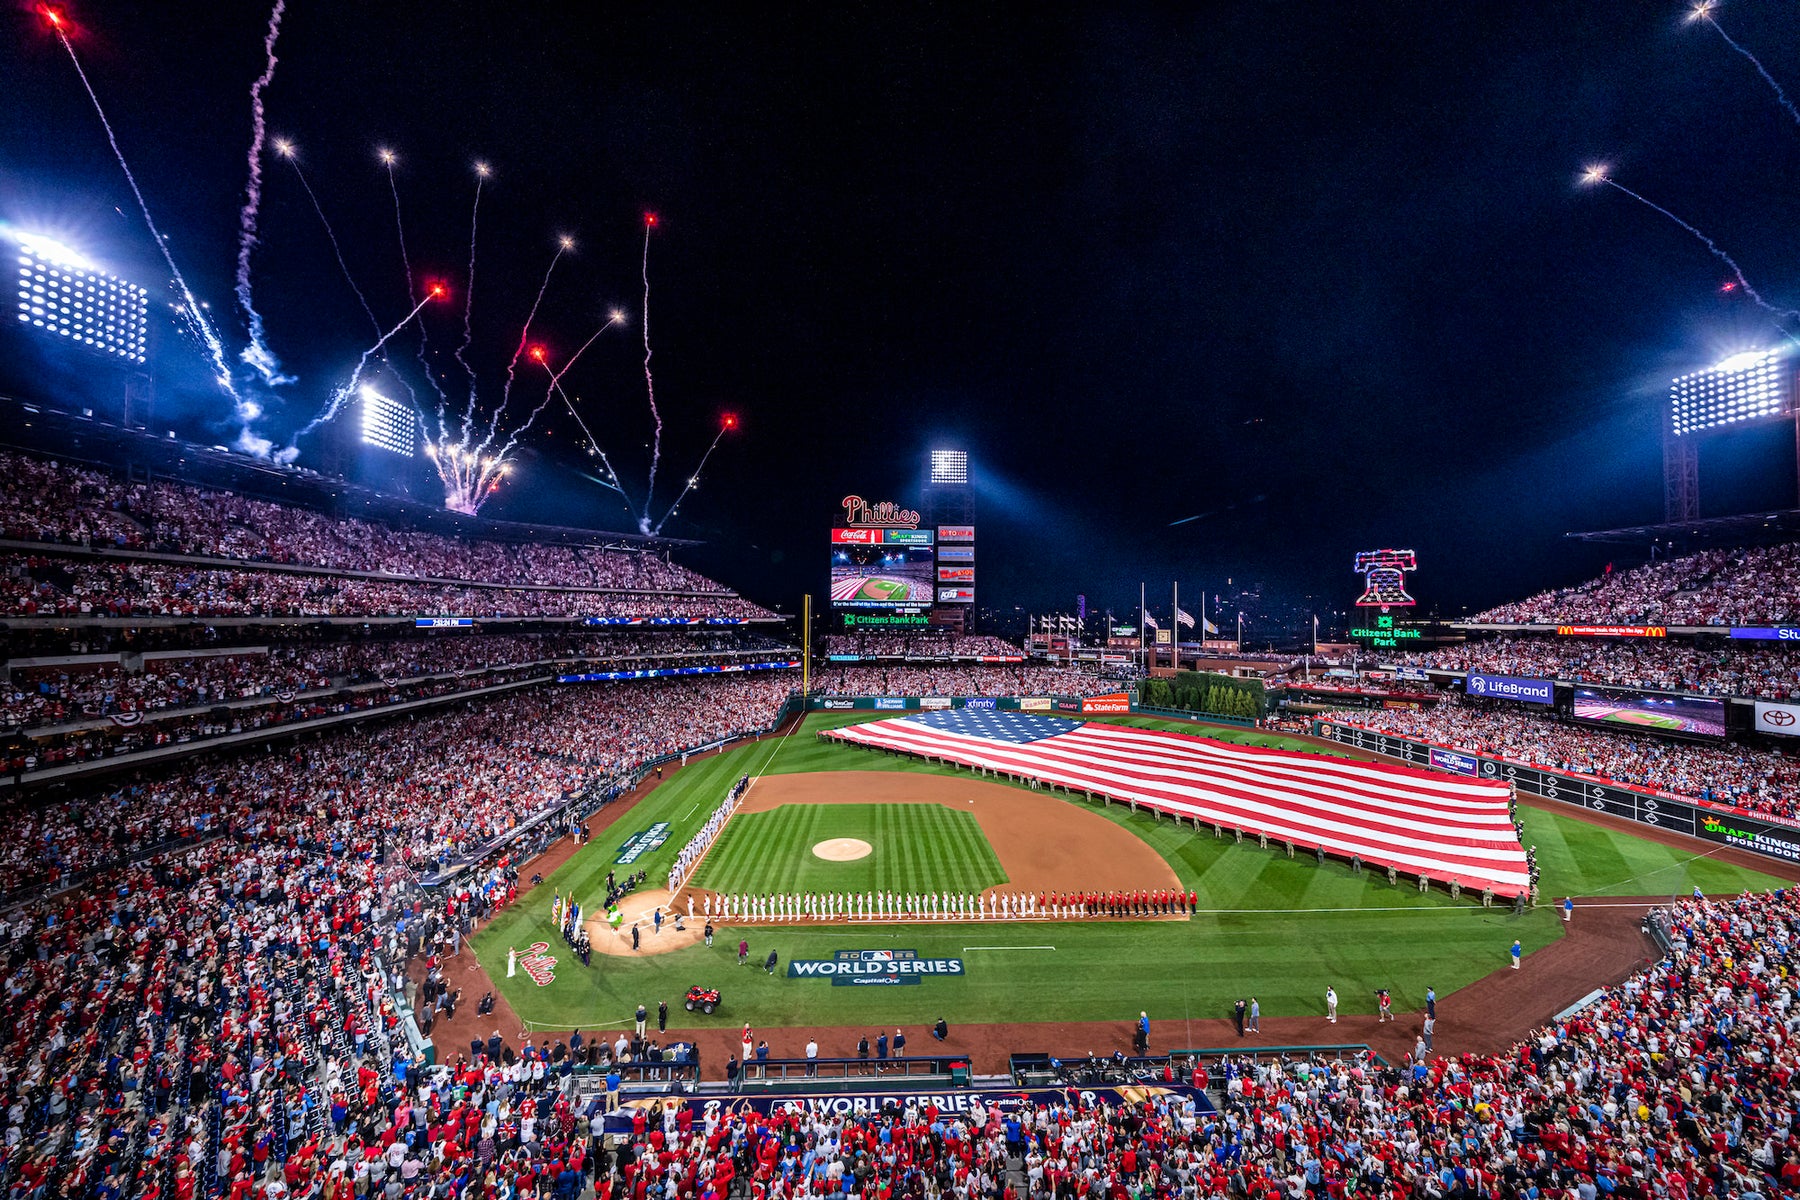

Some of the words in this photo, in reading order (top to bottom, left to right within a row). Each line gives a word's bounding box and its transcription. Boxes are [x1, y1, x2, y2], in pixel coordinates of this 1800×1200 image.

[842, 495, 920, 528] Phillies
[857, 616, 888, 624] Citizens
[890, 616, 910, 624] Bank
[911, 616, 929, 624] Park
[1352, 629, 1392, 637] Citizens
[1394, 630, 1420, 638] Bank
[1374, 638, 1397, 646] Park
[1489, 682, 1548, 697] LifeBrand
[967, 699, 995, 708] xfinity
[1434, 755, 1454, 765] WORLD
[1455, 760, 1472, 770] SERIES
[1704, 823, 1800, 852] DRAFTKINGS
[1725, 835, 1800, 859] SPORTSBOOK
[514, 941, 558, 987] Phillies
[793, 962, 883, 975] WORLD
[886, 960, 961, 973] SERIES
